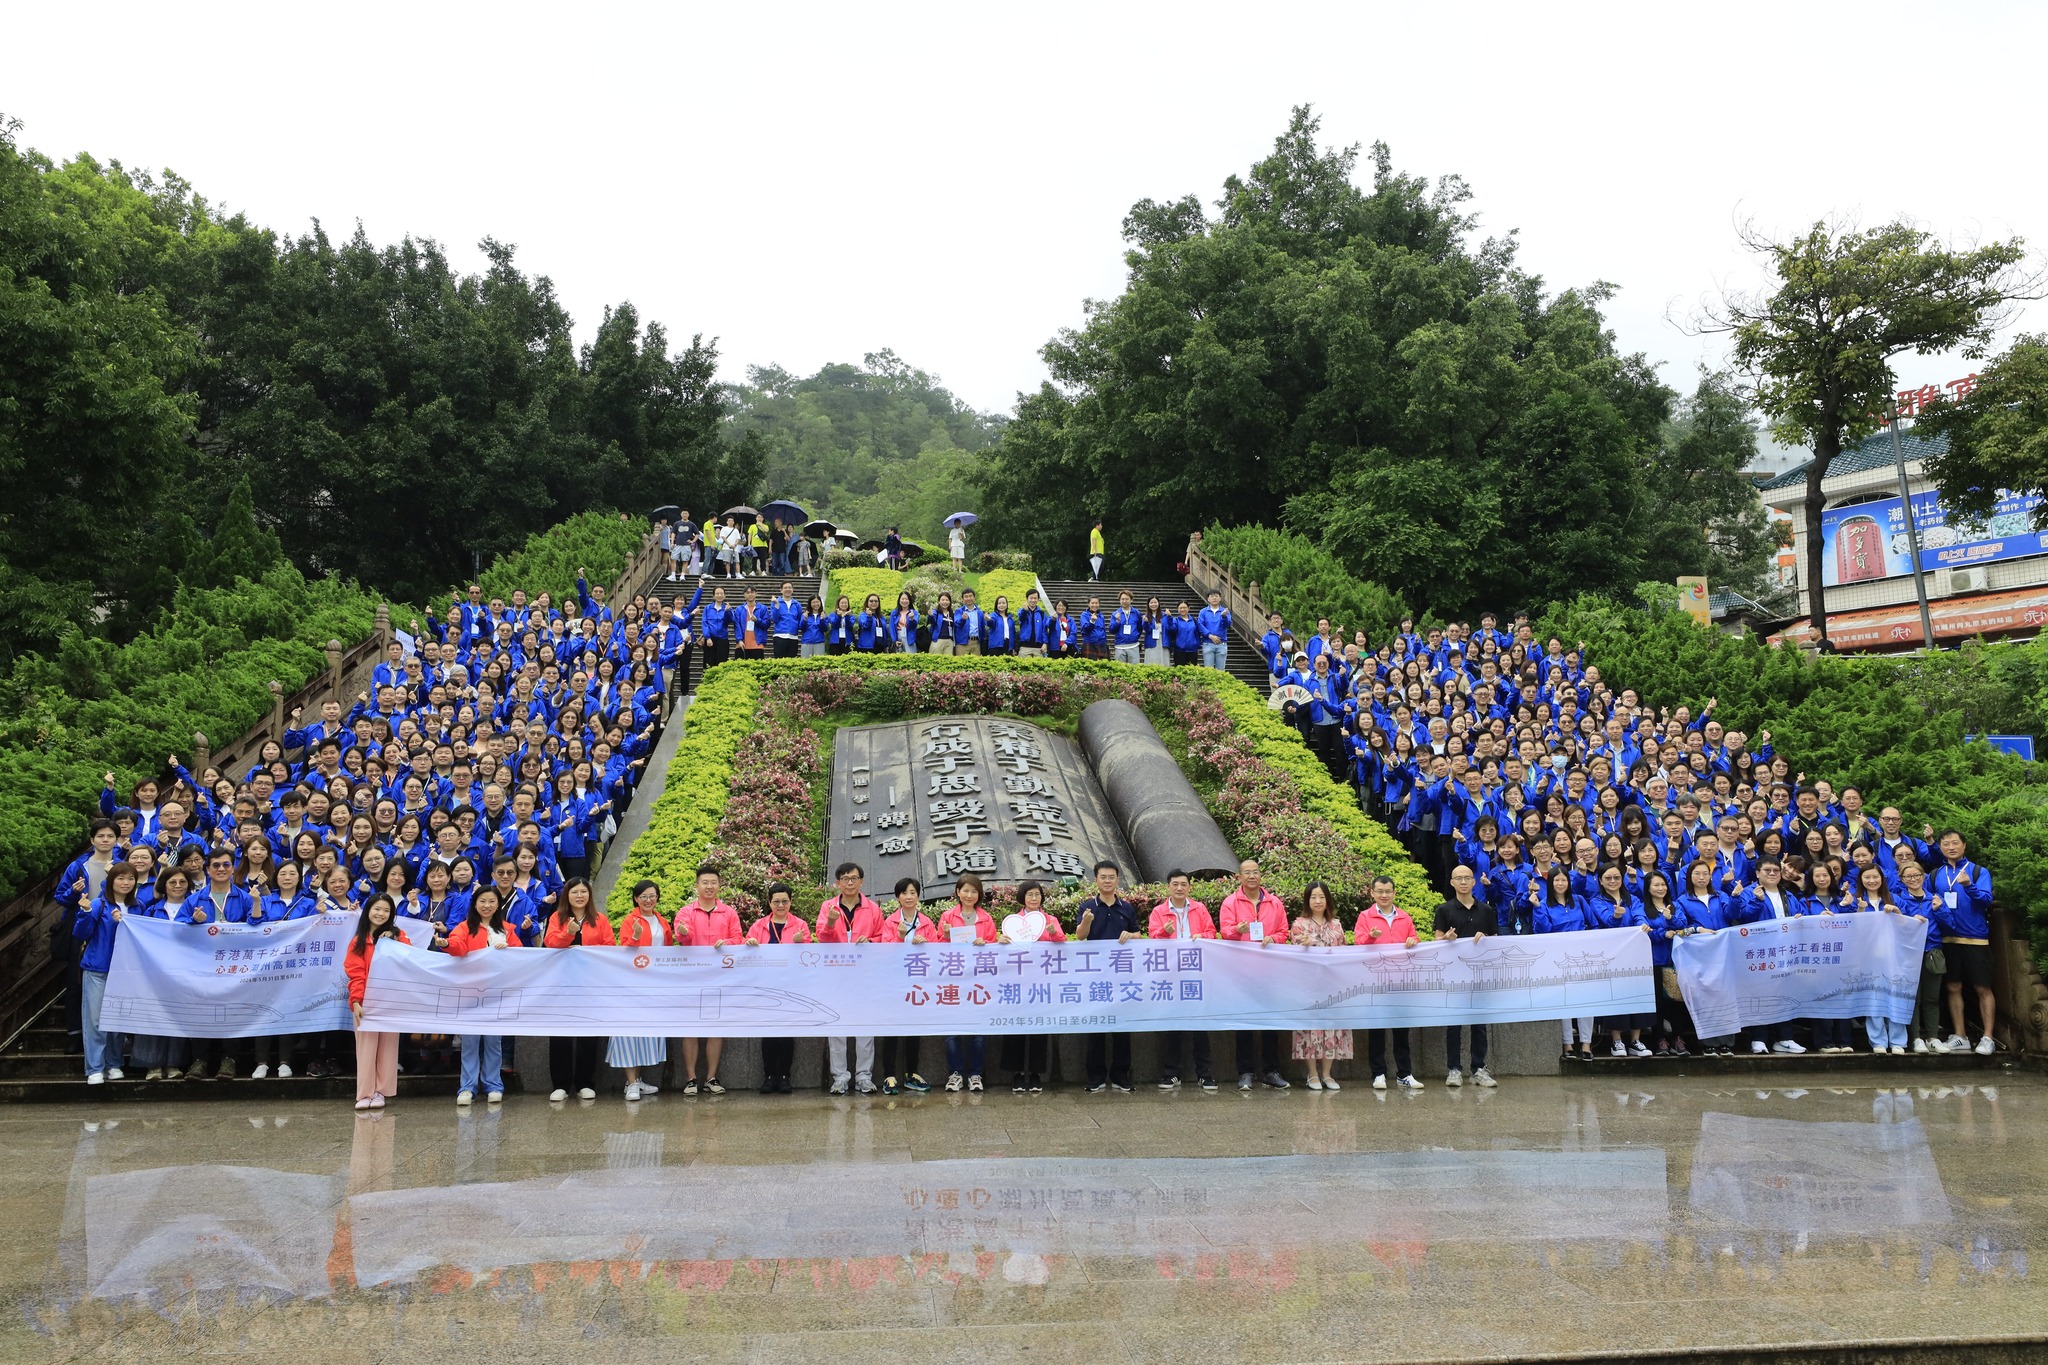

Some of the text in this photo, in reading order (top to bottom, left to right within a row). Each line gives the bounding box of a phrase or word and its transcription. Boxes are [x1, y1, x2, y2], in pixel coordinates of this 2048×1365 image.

[1745, 941, 1844, 960] 香港萬千社工看祖國
[903, 947, 1204, 978] 香港萬千社工看祖國
[1748, 955, 1841, 972] 心連心潮州高鐵交流團
[905, 979, 1204, 1007] 心連心潮州高鐵交流團
[989, 1015, 1118, 1027] 2024年5月31日至6月2日
